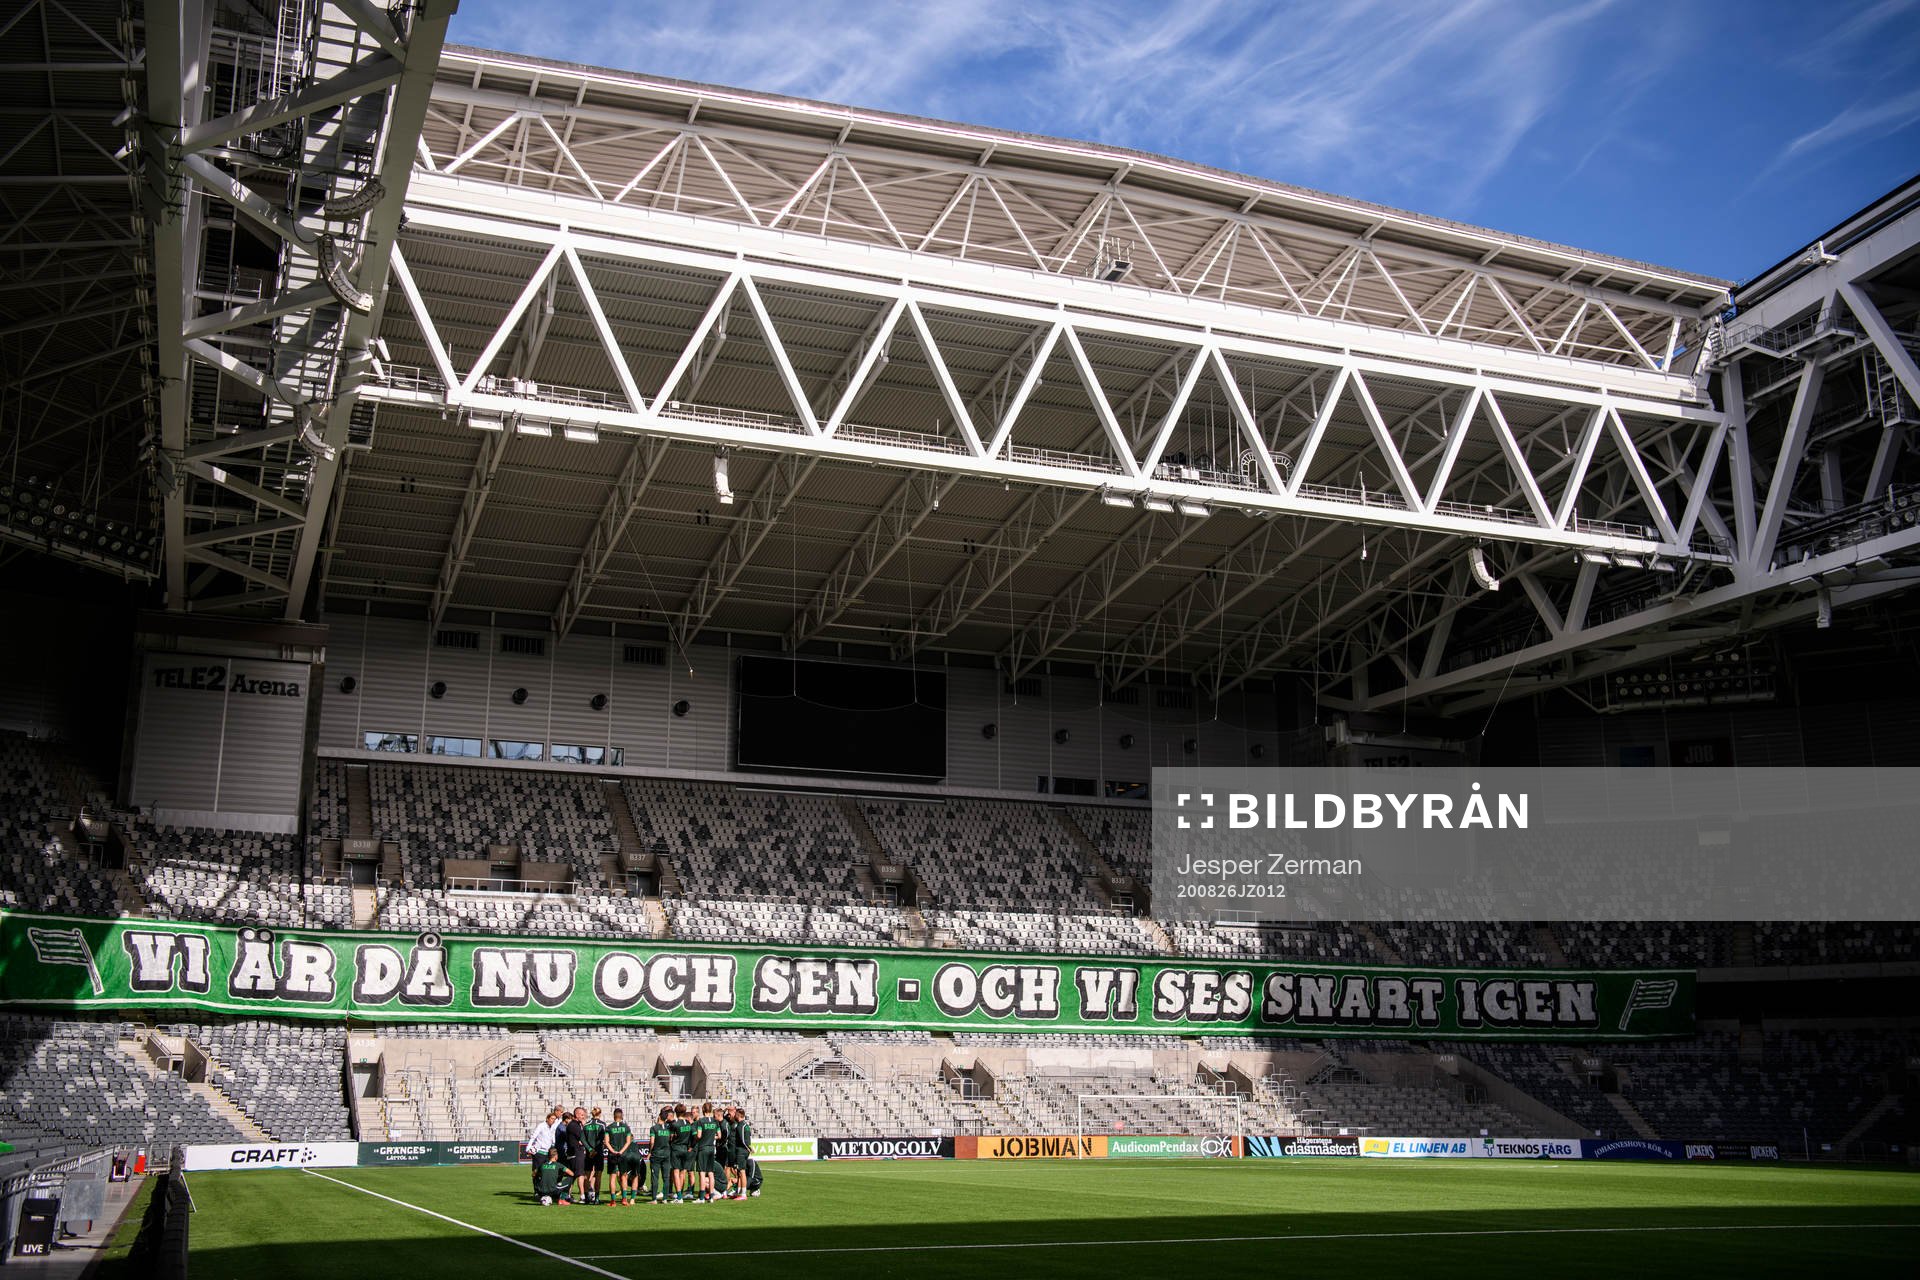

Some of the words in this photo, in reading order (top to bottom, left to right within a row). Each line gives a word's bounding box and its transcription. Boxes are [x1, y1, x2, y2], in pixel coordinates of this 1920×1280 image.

[154, 665, 226, 691] TELE2
[230, 674, 301, 697] Arena
[122, 930, 210, 994] VI
[228, 927, 337, 1004] ÄR
[352, 932, 455, 1007] DÅ
[471, 947, 577, 1008] NU
[595, 951, 737, 1013] OCH
[751, 954, 879, 1016] SEN
[932, 962, 1061, 1020] OCH
[1075, 966, 1140, 1022] VI
[1152, 967, 1254, 1023] SES
[1261, 971, 1446, 1028] SNART
[1454, 977, 1600, 1030] IGEN
[831, 1140, 942, 1156] METODGOLV
[993, 1138, 1092, 1157] JOBMAN
[1112, 1141, 1199, 1153] AudicomPendax
[1284, 1141, 1359, 1156] glasmästeri
[1393, 1142, 1406, 1153] EL
[1409, 1142, 1450, 1154] LINJEN
[1451, 1143, 1466, 1154] AB
[1496, 1144, 1540, 1155] TEKNOS
[1541, 1142, 1572, 1155] FÄRG
[230, 1149, 300, 1164] CRAFT
[22, 1244, 44, 1254] LIVE
